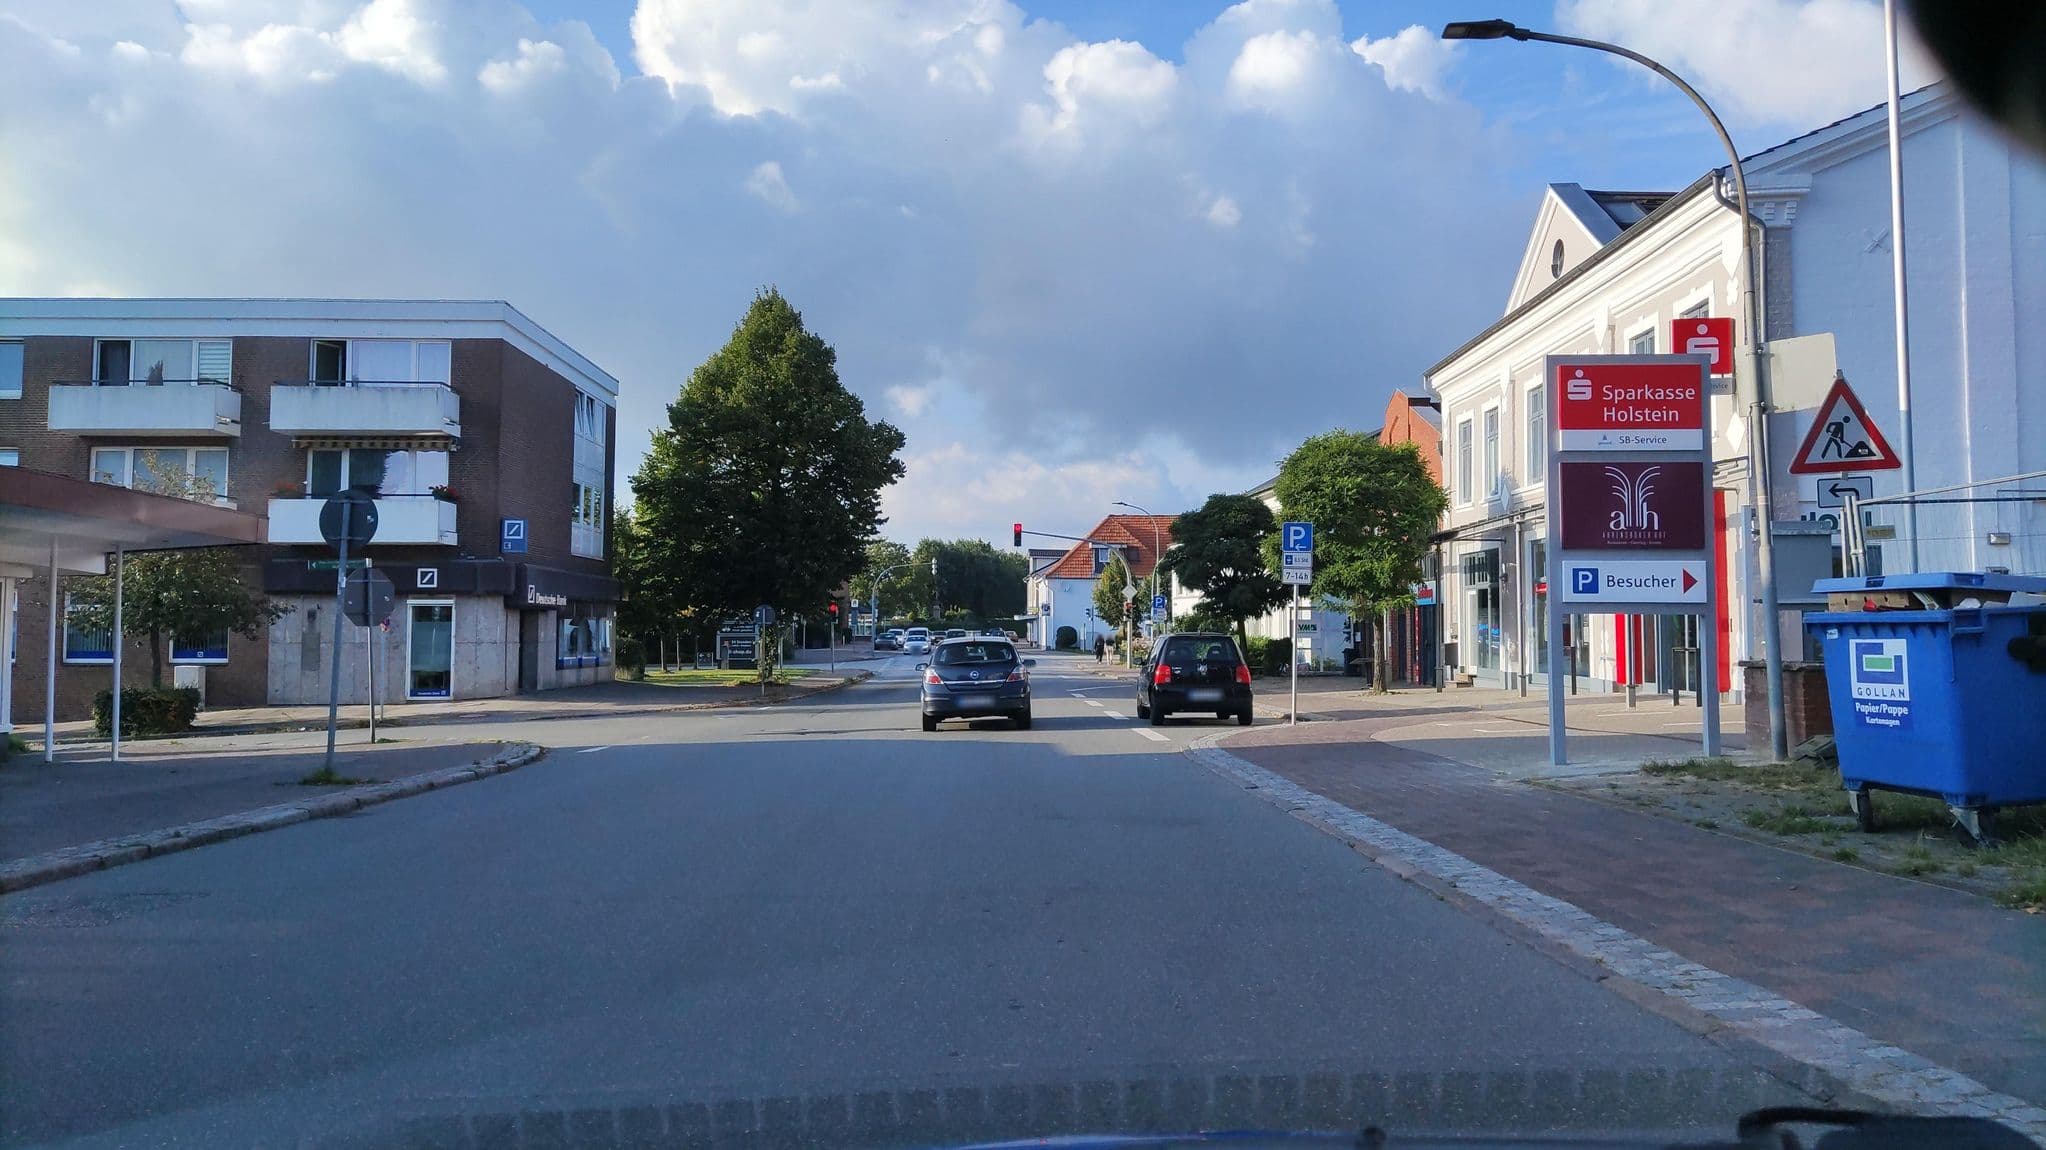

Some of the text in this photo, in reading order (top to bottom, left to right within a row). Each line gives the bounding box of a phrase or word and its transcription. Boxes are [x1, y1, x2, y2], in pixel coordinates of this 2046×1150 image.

[1602, 384, 1696, 404] Sparkasse
[1603, 406, 1680, 422] Holstein
[1618, 435, 1668, 445] SB-Service
[1289, 526, 1306, 548] P
[1577, 571, 1677, 592] P Besucher
[1857, 687, 1906, 698] GOLLAN
[1855, 702, 1909, 717] Papier/Pappe
